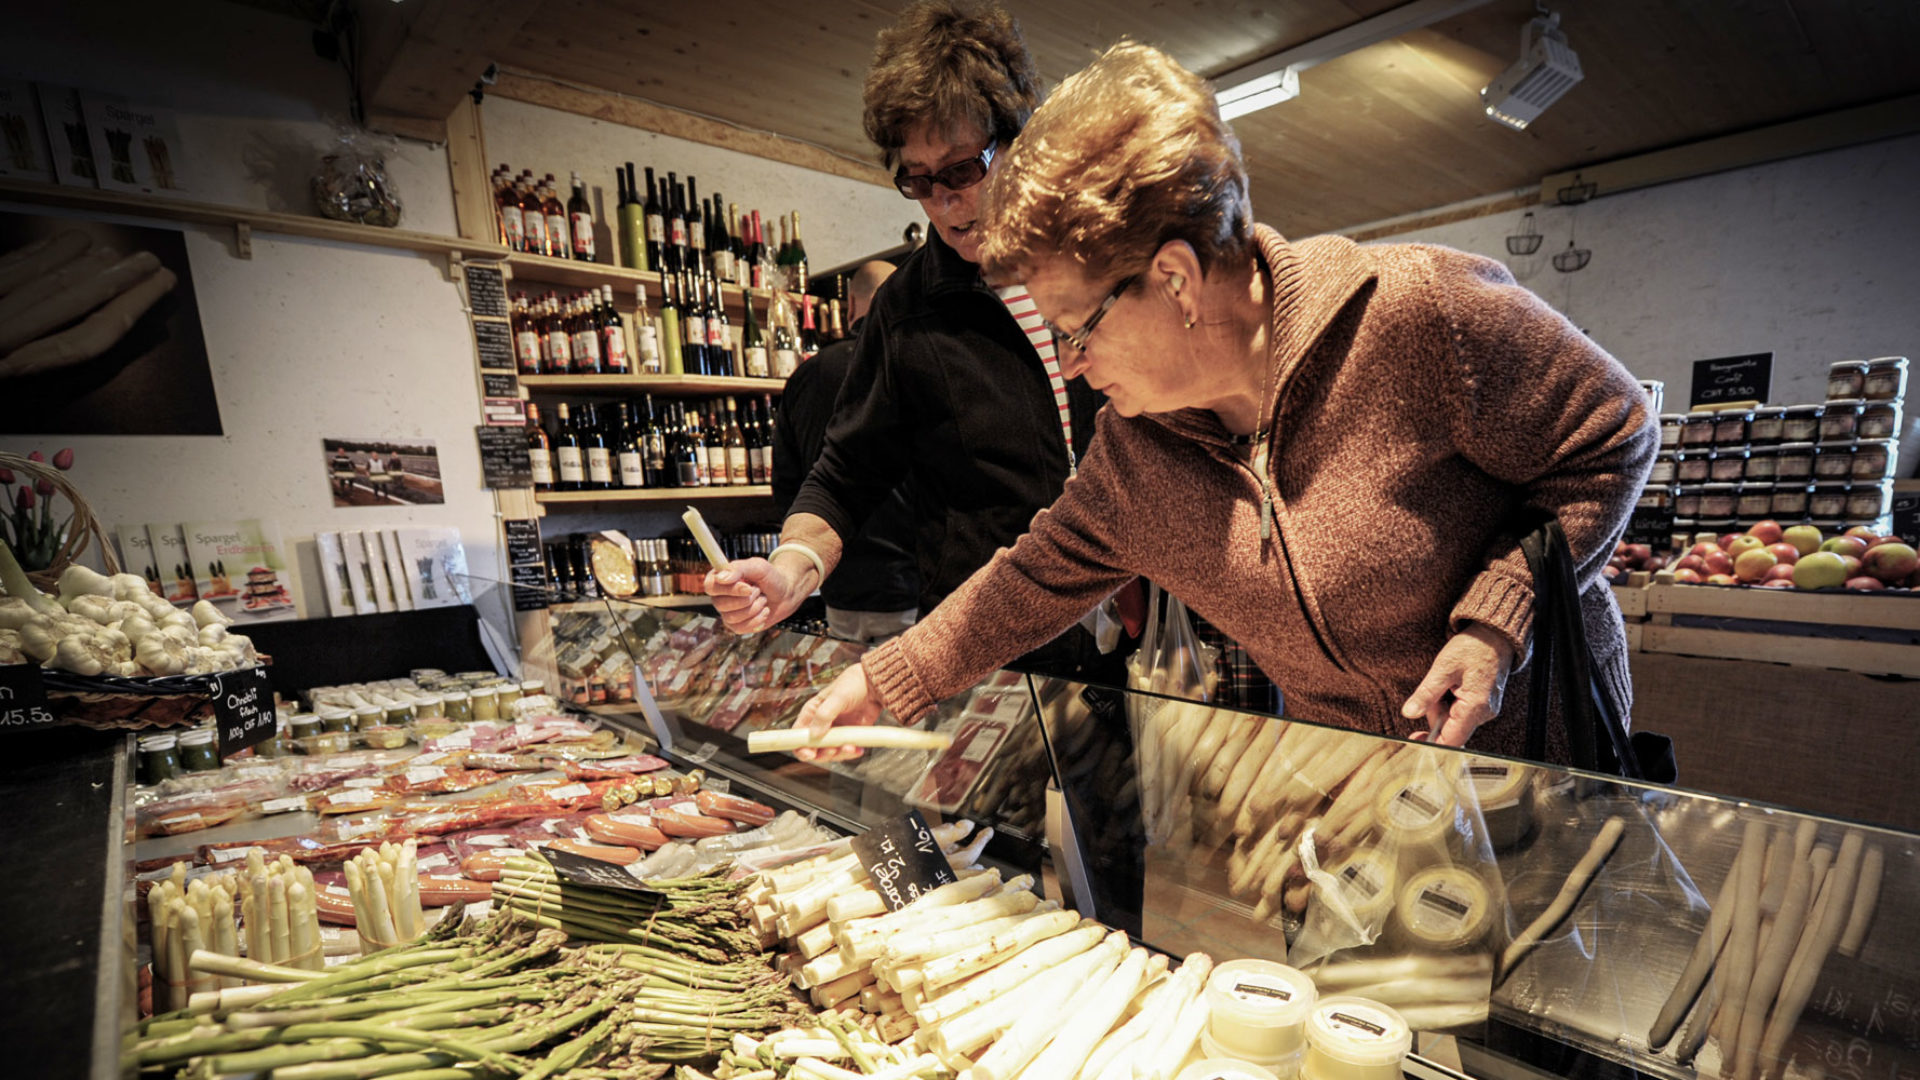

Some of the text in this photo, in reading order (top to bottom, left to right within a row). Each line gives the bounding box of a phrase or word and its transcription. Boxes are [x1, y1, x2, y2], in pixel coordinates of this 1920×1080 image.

[104, 104, 155, 126] Spargel
[196, 532, 241, 545] Spargel
[216, 544, 275, 556] Erdbeeren
[228, 726, 244, 742] 100g
[244, 718, 256, 731] CHF
[870, 862, 905, 912] pargel
